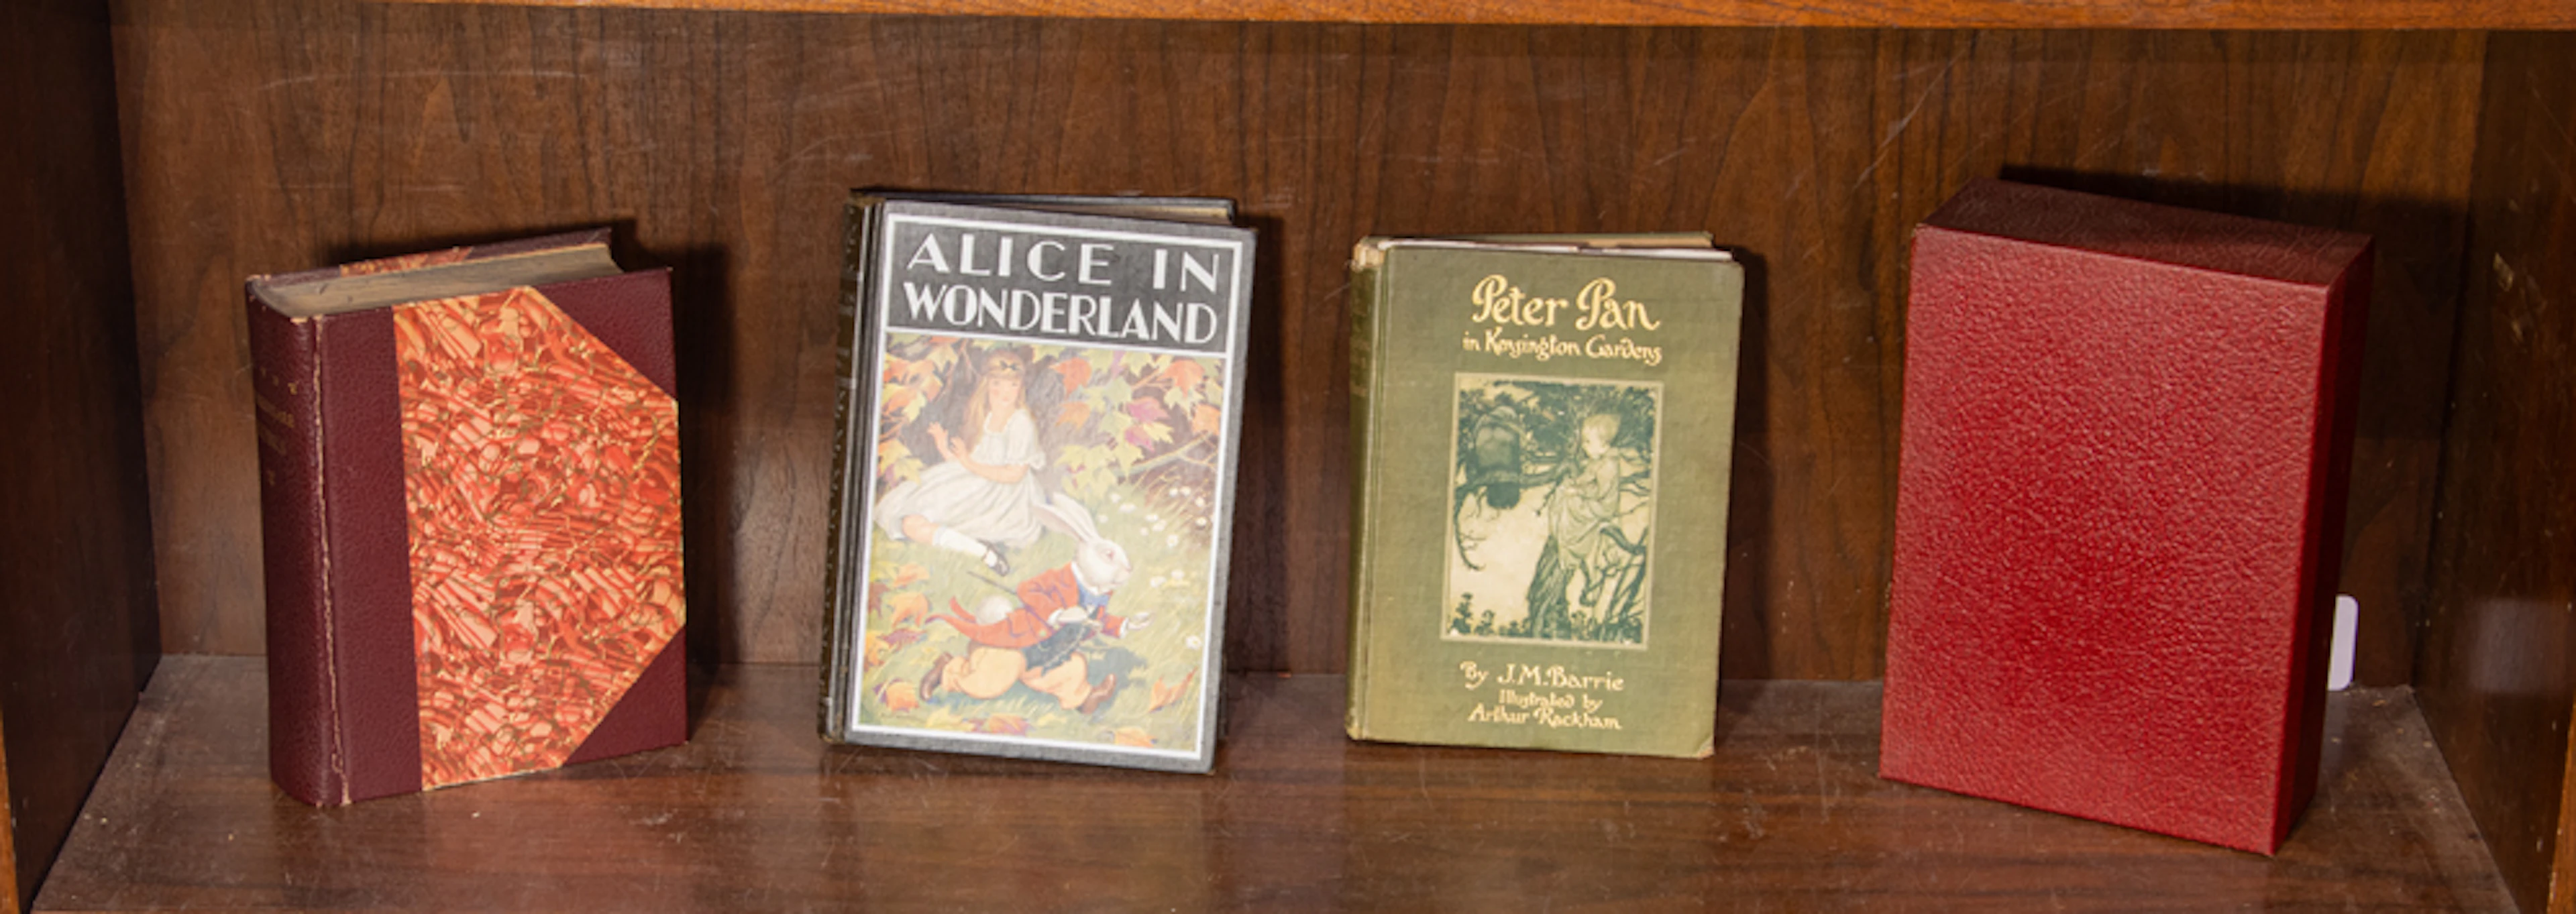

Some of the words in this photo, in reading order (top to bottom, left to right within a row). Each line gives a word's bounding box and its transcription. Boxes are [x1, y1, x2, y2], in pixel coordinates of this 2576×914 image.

[906, 233, 1114, 286] ALICE
[1152, 249, 1220, 292] IN
[903, 282, 1218, 344] WONDERLAND
[1471, 274, 1570, 326] Peter
[1575, 277, 1661, 331] Pan
[1462, 331, 1481, 352] in
[1484, 326, 1582, 361] Kensington
[1585, 334, 1663, 367] Gardens
[1459, 660, 1490, 690] By
[1467, 702, 1530, 724] Arthur
[1533, 706, 1623, 730] Rackham
[1499, 689, 1576, 709] Illustrated
[1582, 693, 1604, 714] by
